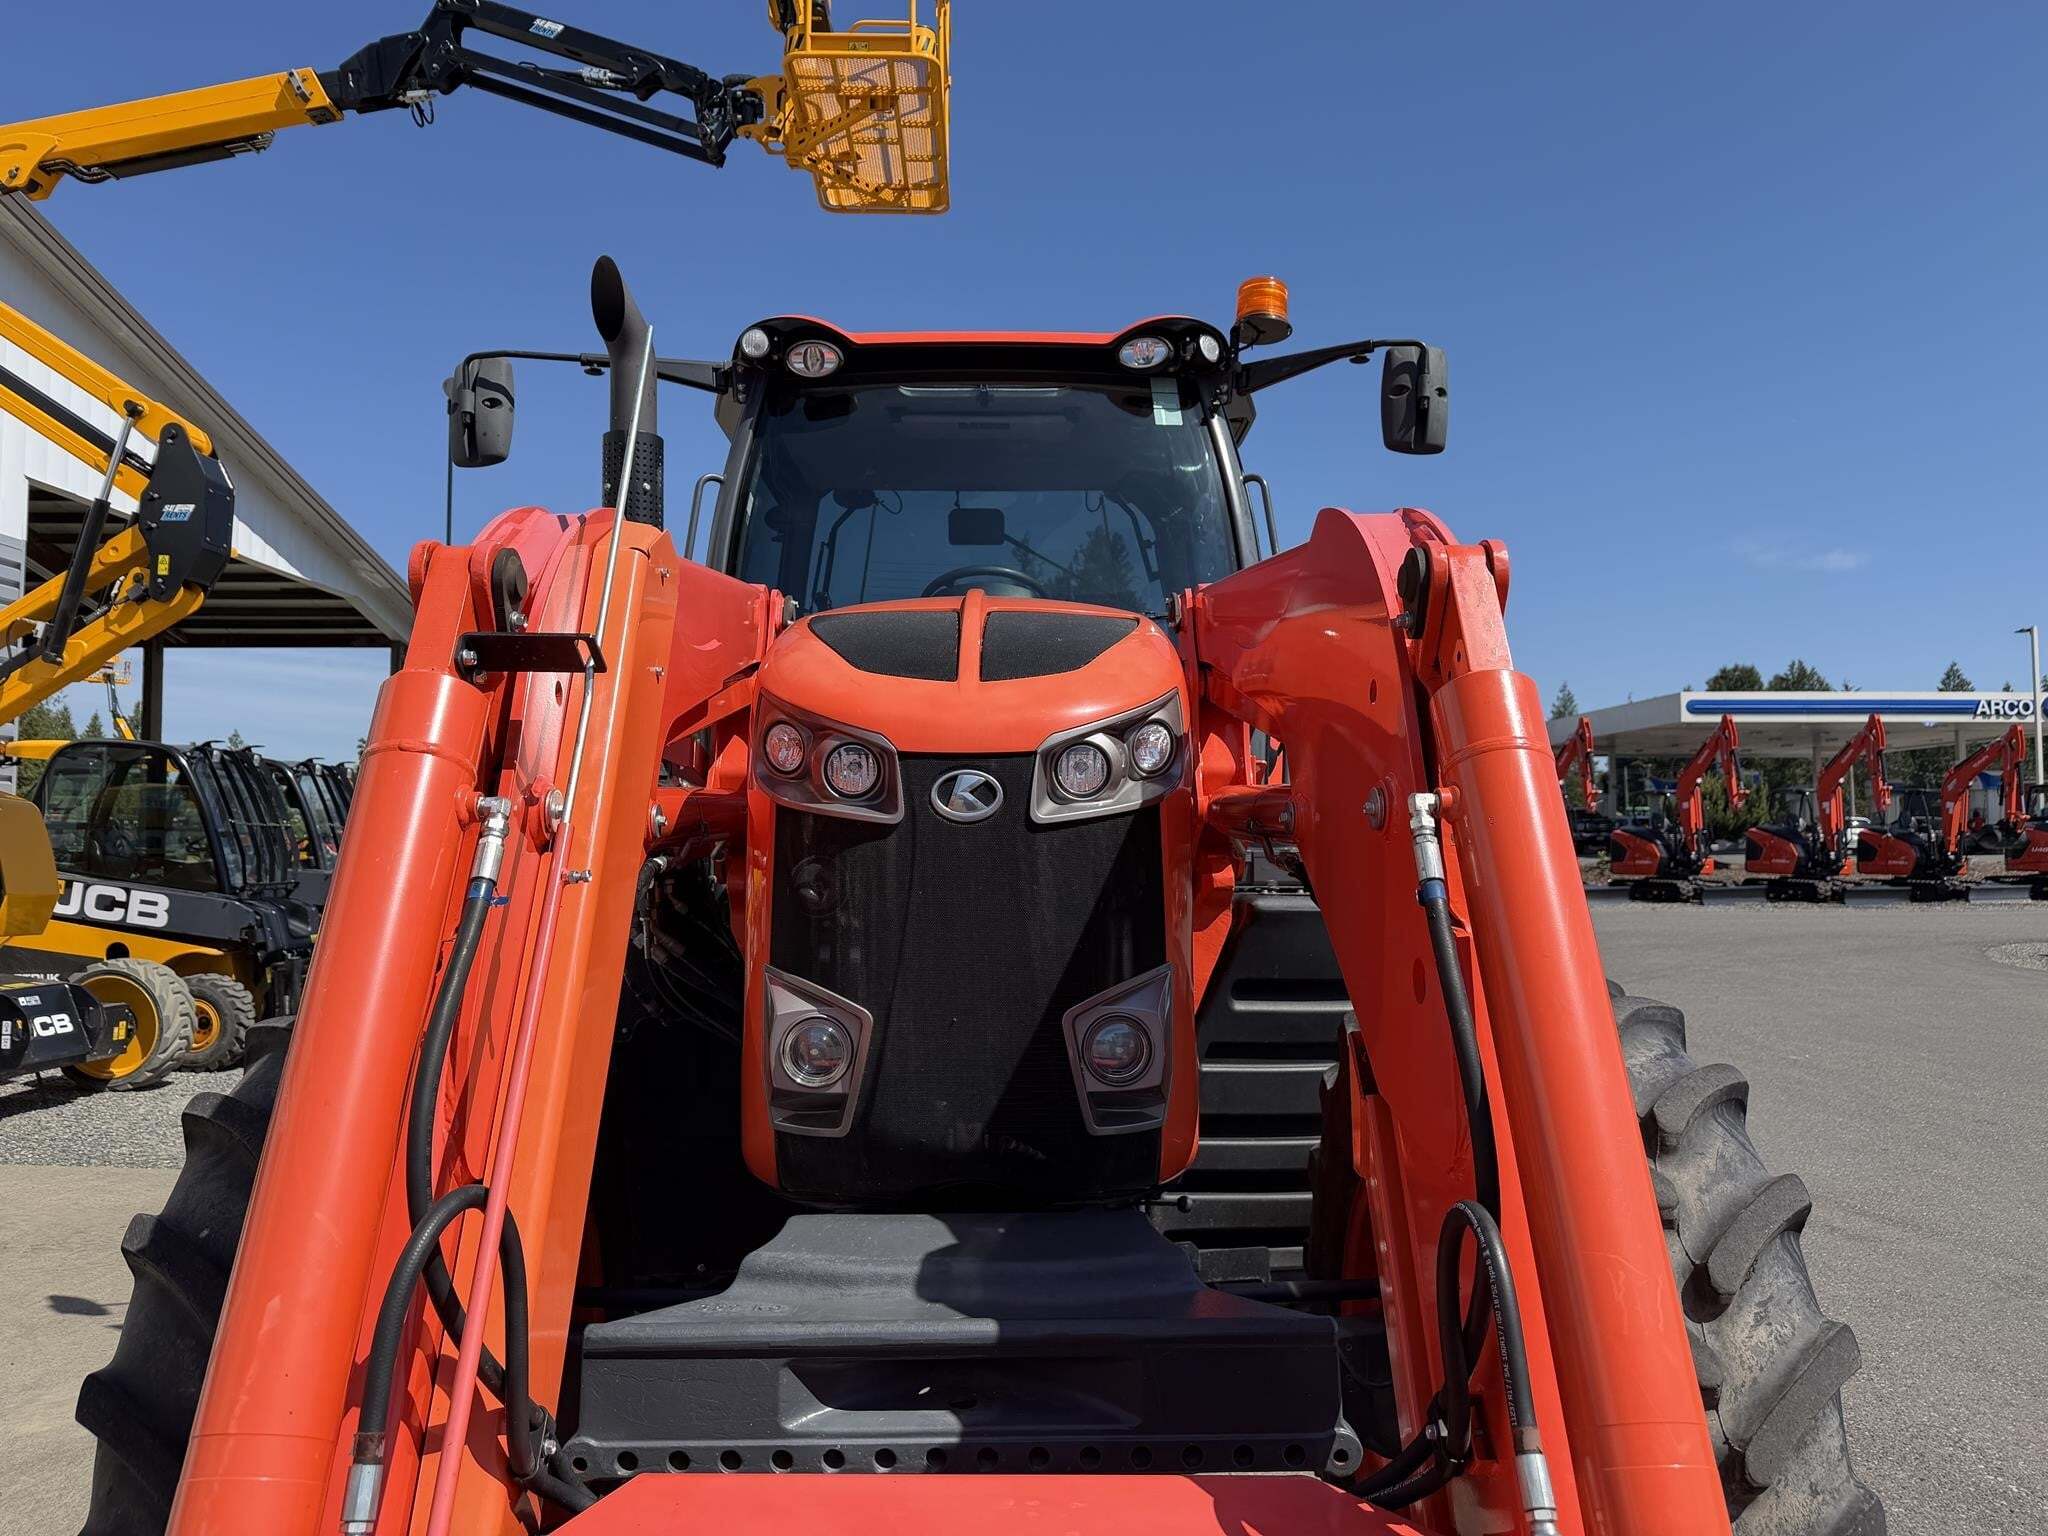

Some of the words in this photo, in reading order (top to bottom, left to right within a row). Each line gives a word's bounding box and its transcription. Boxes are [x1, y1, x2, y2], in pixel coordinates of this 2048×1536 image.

[164, 511, 188, 519] RENTS
[1976, 700, 2034, 716] ARCO
[53, 881, 170, 928] JCB
